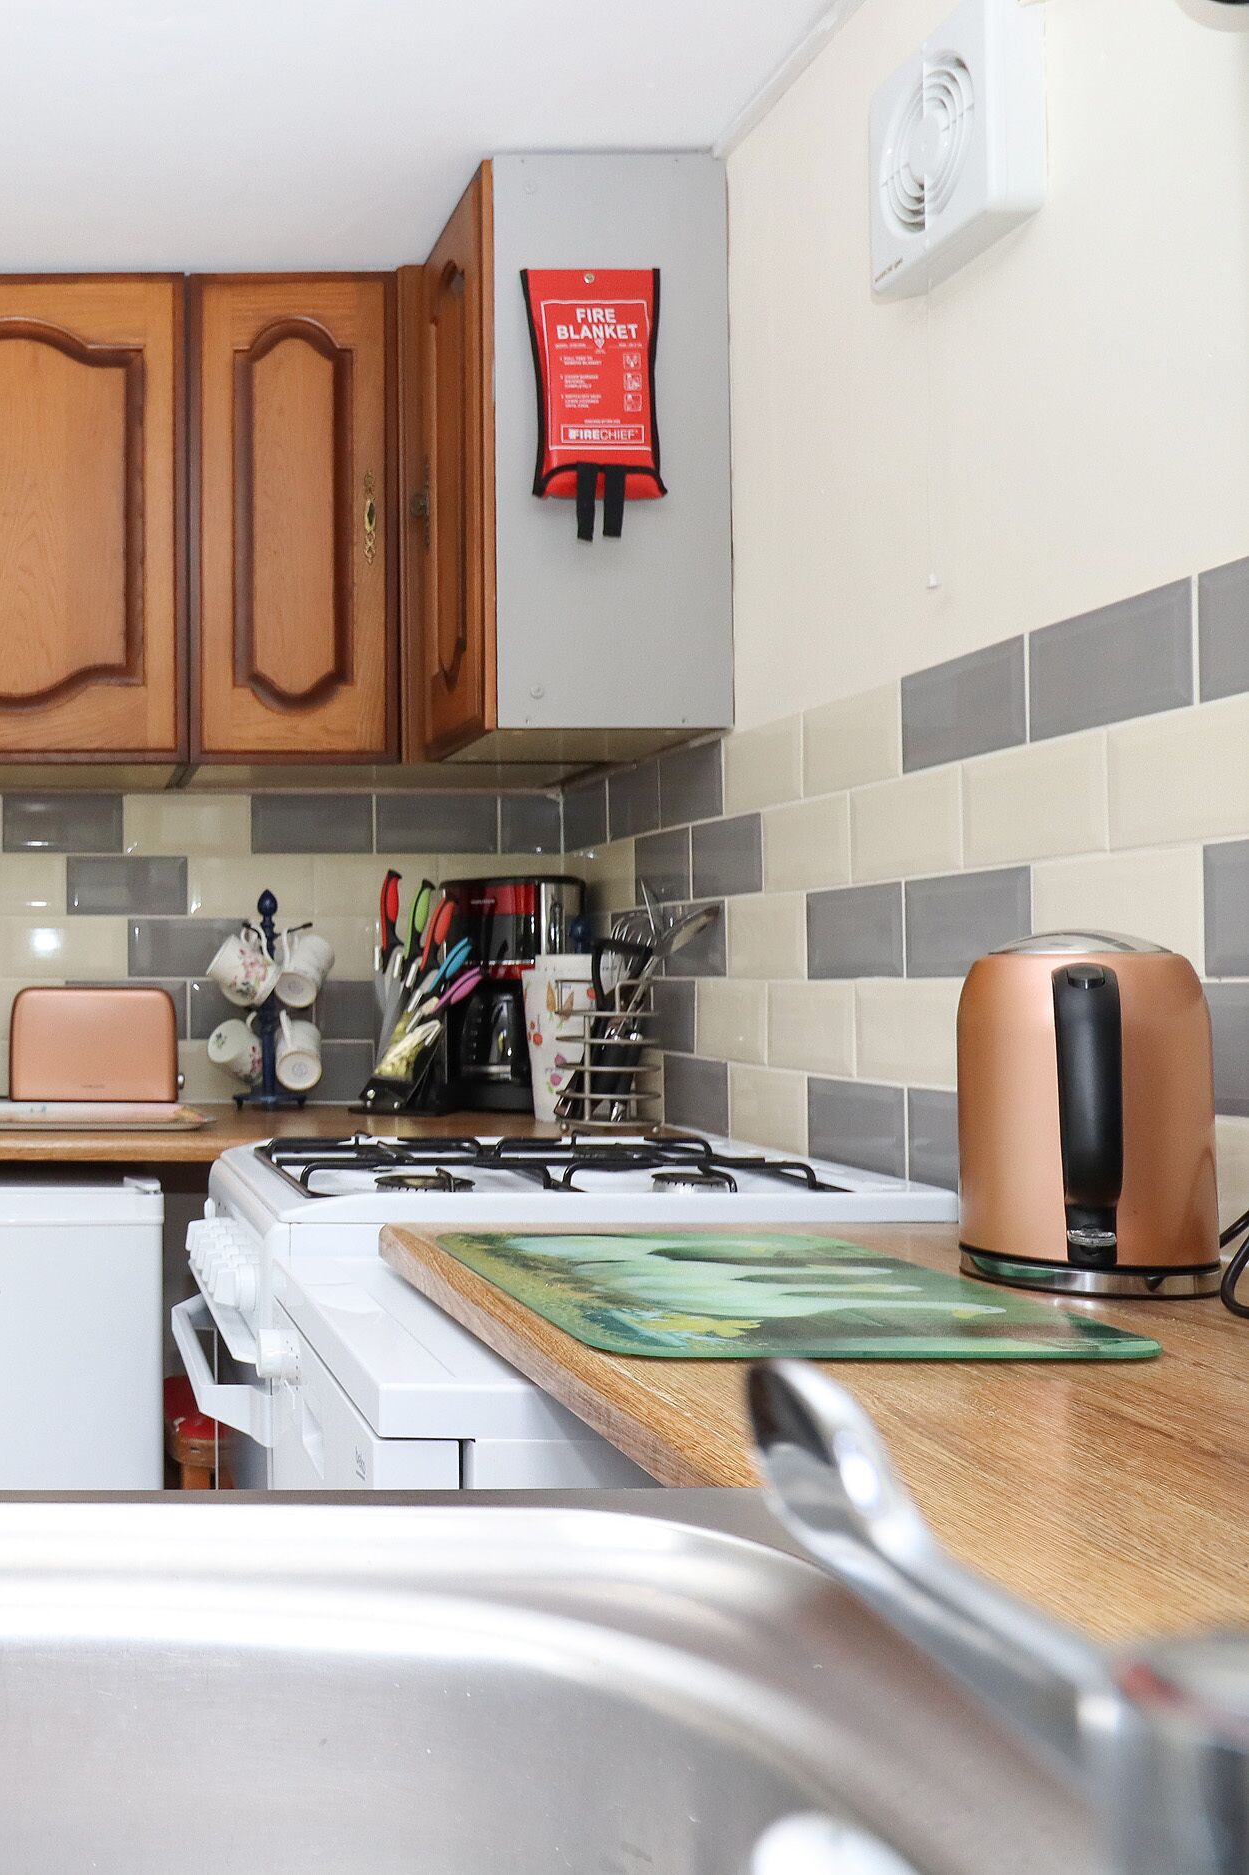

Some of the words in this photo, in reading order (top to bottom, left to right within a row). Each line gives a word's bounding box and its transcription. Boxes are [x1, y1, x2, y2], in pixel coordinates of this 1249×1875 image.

[575, 307, 617, 324] FIRE
[556, 323, 638, 340] BLANKET
[569, 427, 635, 441] FIRECHIEF
